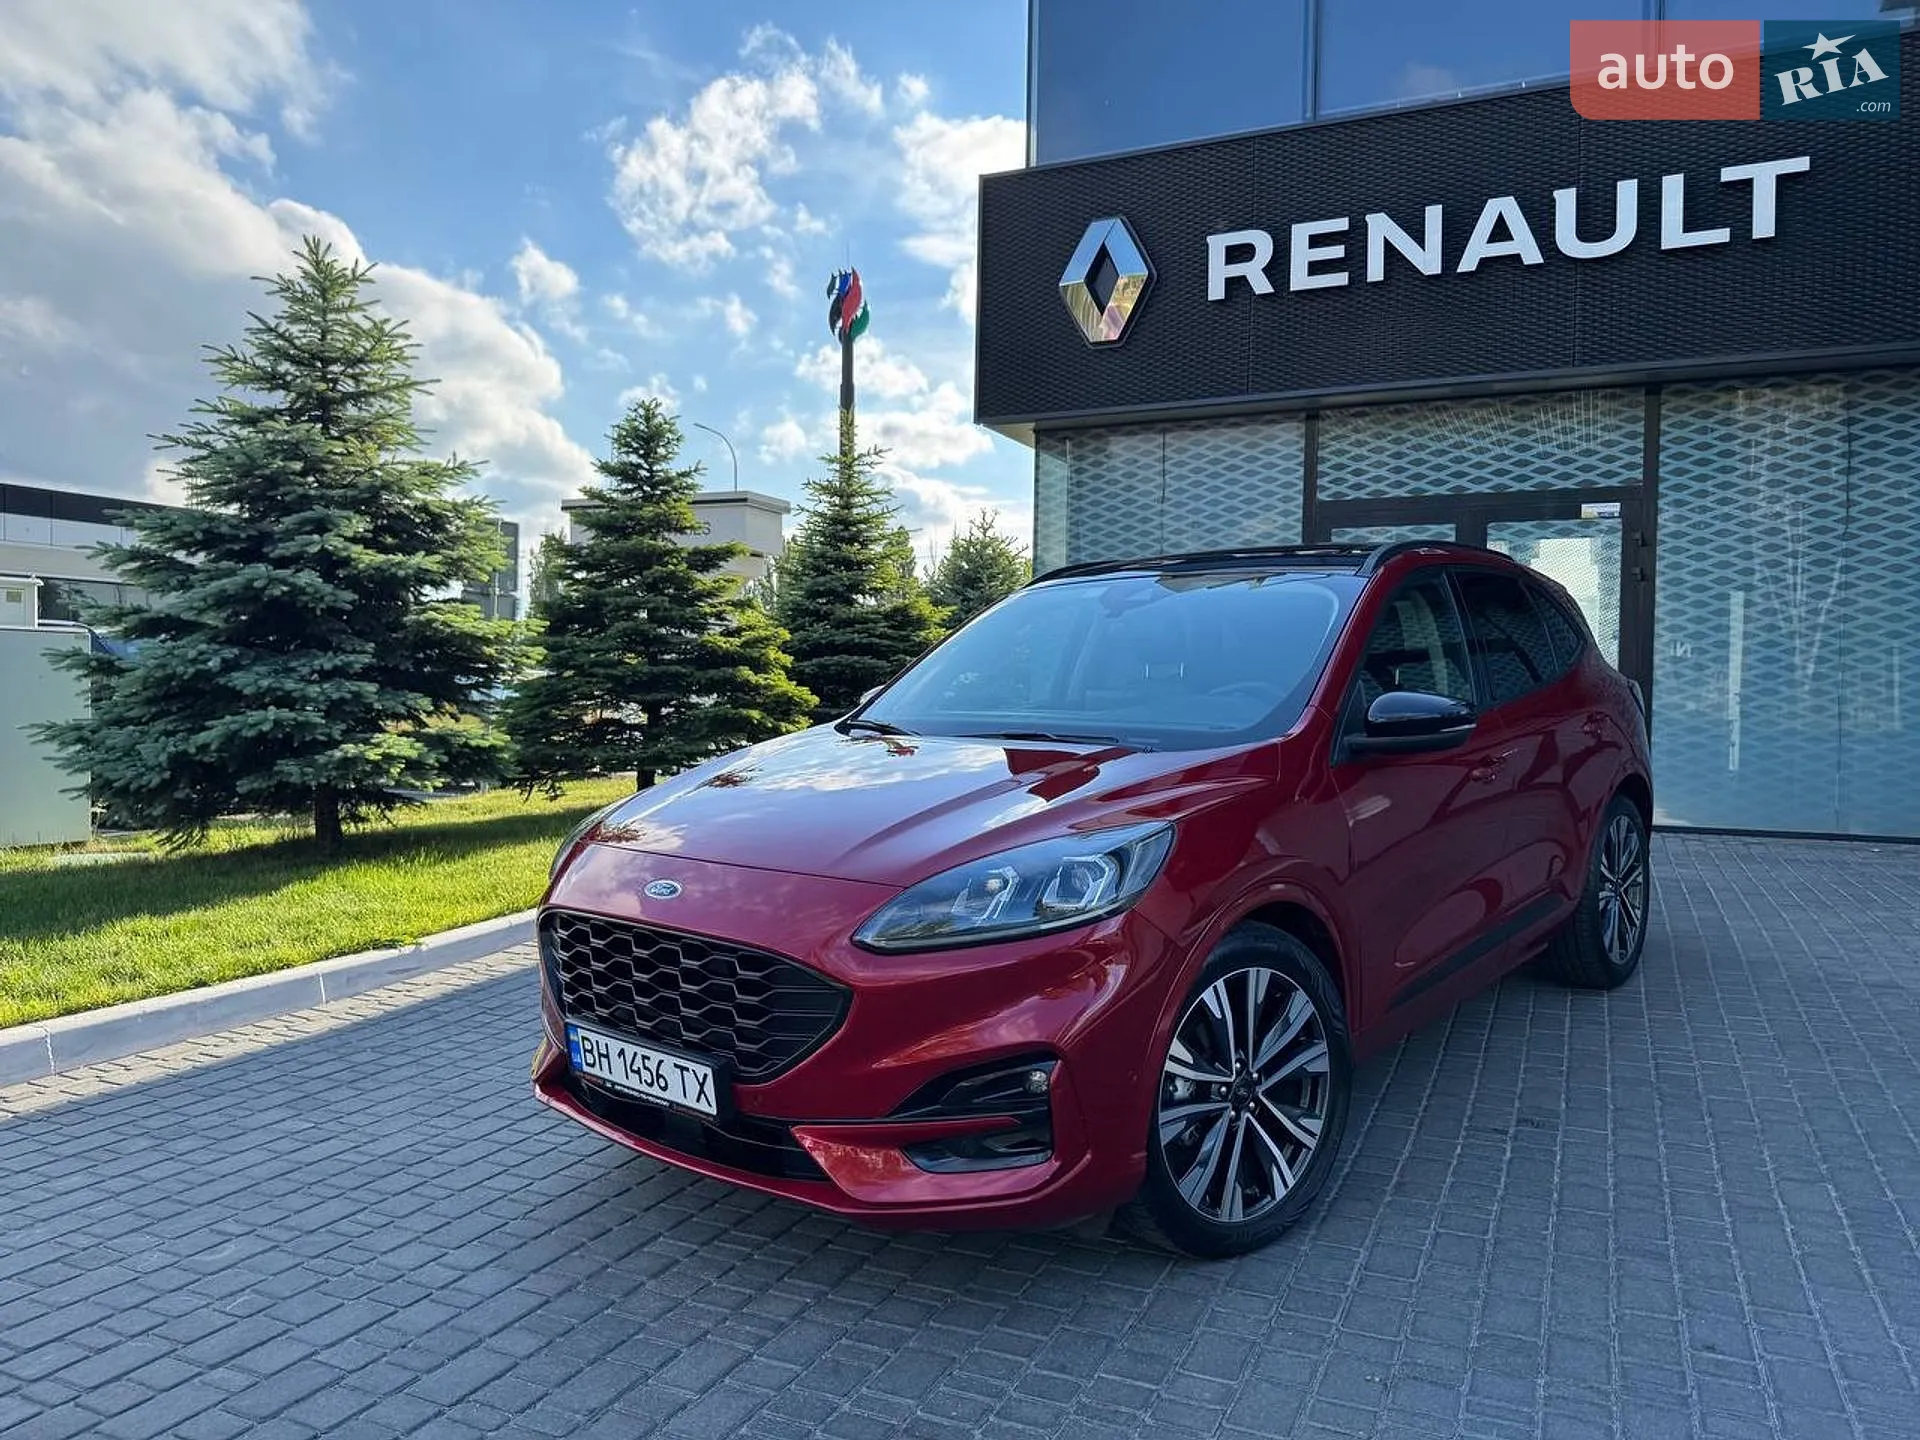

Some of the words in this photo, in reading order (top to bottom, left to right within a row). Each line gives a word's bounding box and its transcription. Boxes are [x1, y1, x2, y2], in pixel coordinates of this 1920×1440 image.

[1206, 155, 1811, 301] RENAULT
[581, 1035, 612, 1075] BH
[617, 1047, 669, 1092] 1456
[673, 1062, 713, 1108] TX
